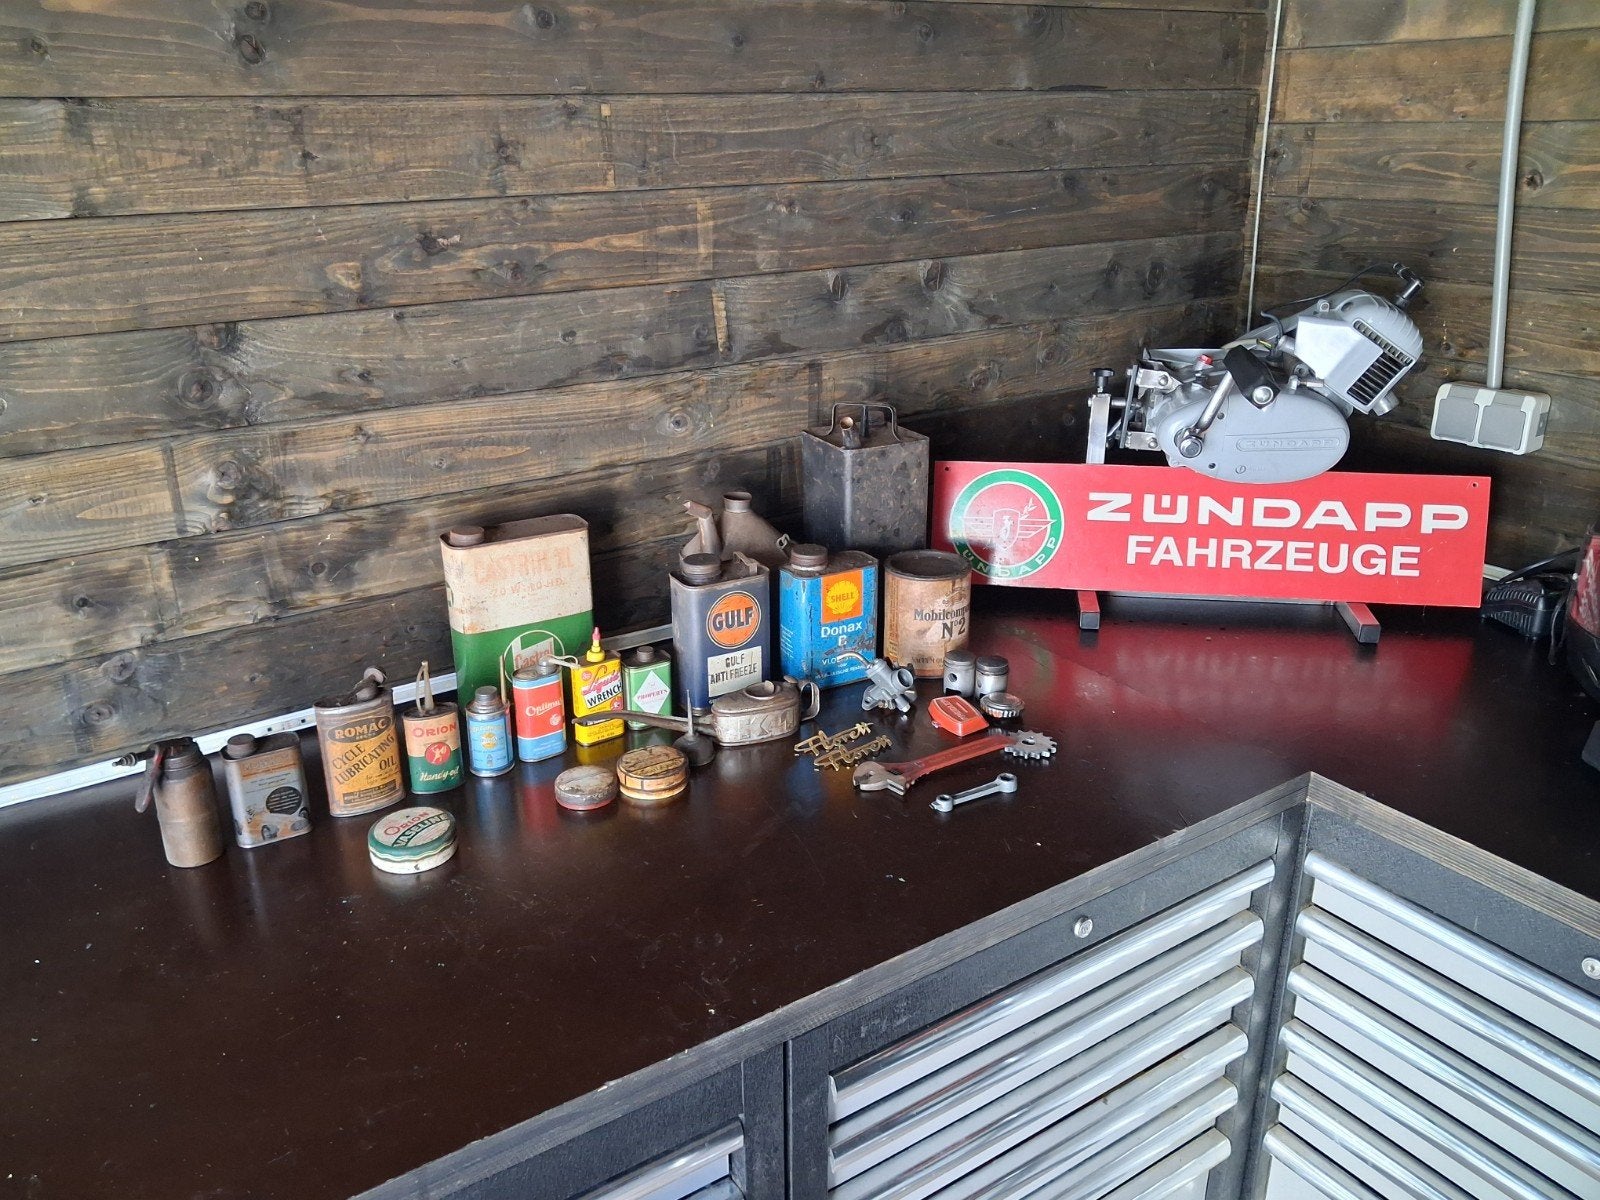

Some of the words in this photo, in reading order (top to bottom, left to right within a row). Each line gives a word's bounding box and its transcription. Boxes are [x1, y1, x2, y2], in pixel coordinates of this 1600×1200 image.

[1086, 492, 1469, 534] ZÜNDAPP
[1126, 535, 1421, 577] FAHRZEUGE
[831, 592, 854, 603] SHELL
[712, 606, 754, 632] GULF
[821, 621, 862, 638] Donax
[725, 653, 745, 668] GULF
[587, 682, 622, 706] WRENCH
[335, 719, 387, 739] ROMAC
[413, 723, 457, 738] ORION
[332, 744, 365, 769] CYCLE
[335, 734, 394, 784] LUBRICATING
[379, 756, 396, 770] OIL
[384, 812, 430, 836] ORION
